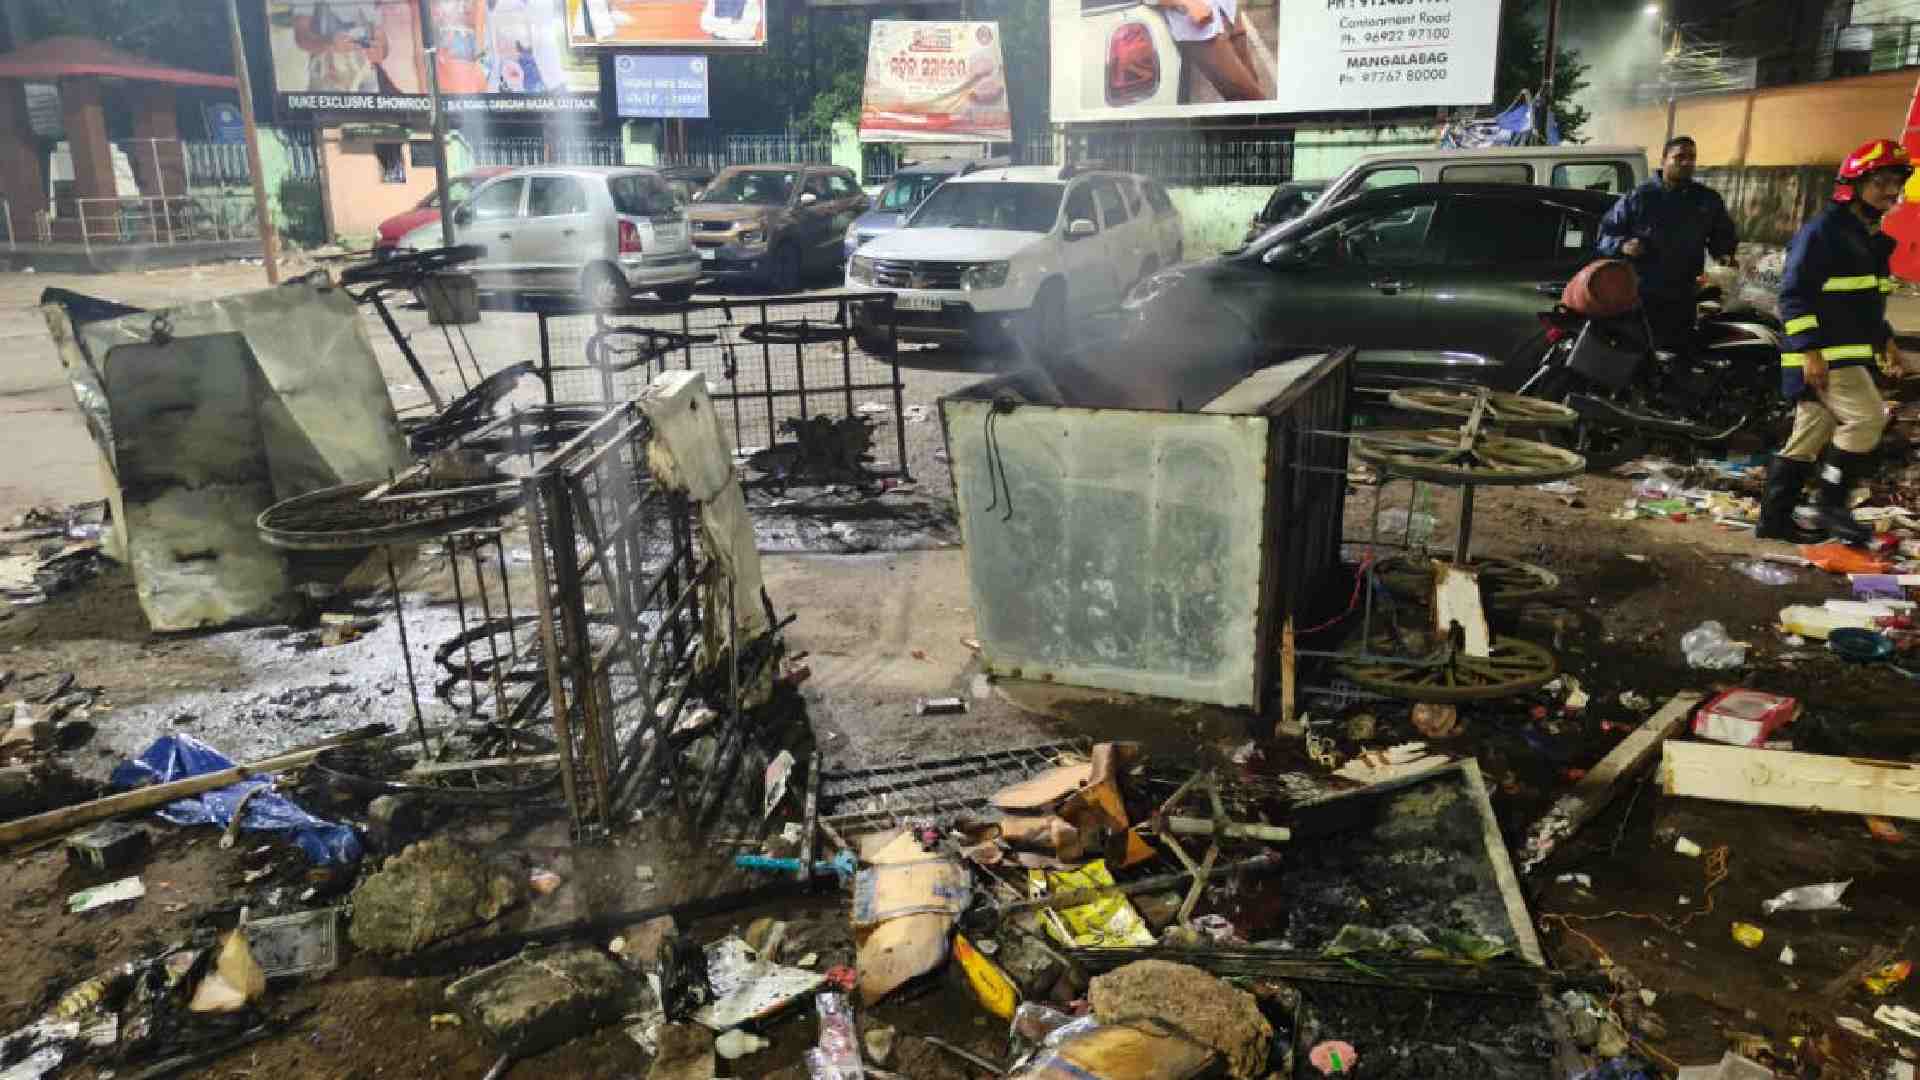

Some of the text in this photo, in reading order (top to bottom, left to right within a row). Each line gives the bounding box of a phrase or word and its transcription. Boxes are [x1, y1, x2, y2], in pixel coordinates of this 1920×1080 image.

[1419, 12, 1451, 24] Road
[1364, 31, 1404, 42] 96922
[1408, 28, 1450, 41] 97100
[1347, 52, 1449, 68] MANGALABAG
[288, 95, 318, 109] DUKE
[320, 95, 375, 109] EXCLUSIVE
[377, 96, 432, 110] SHOWROO
